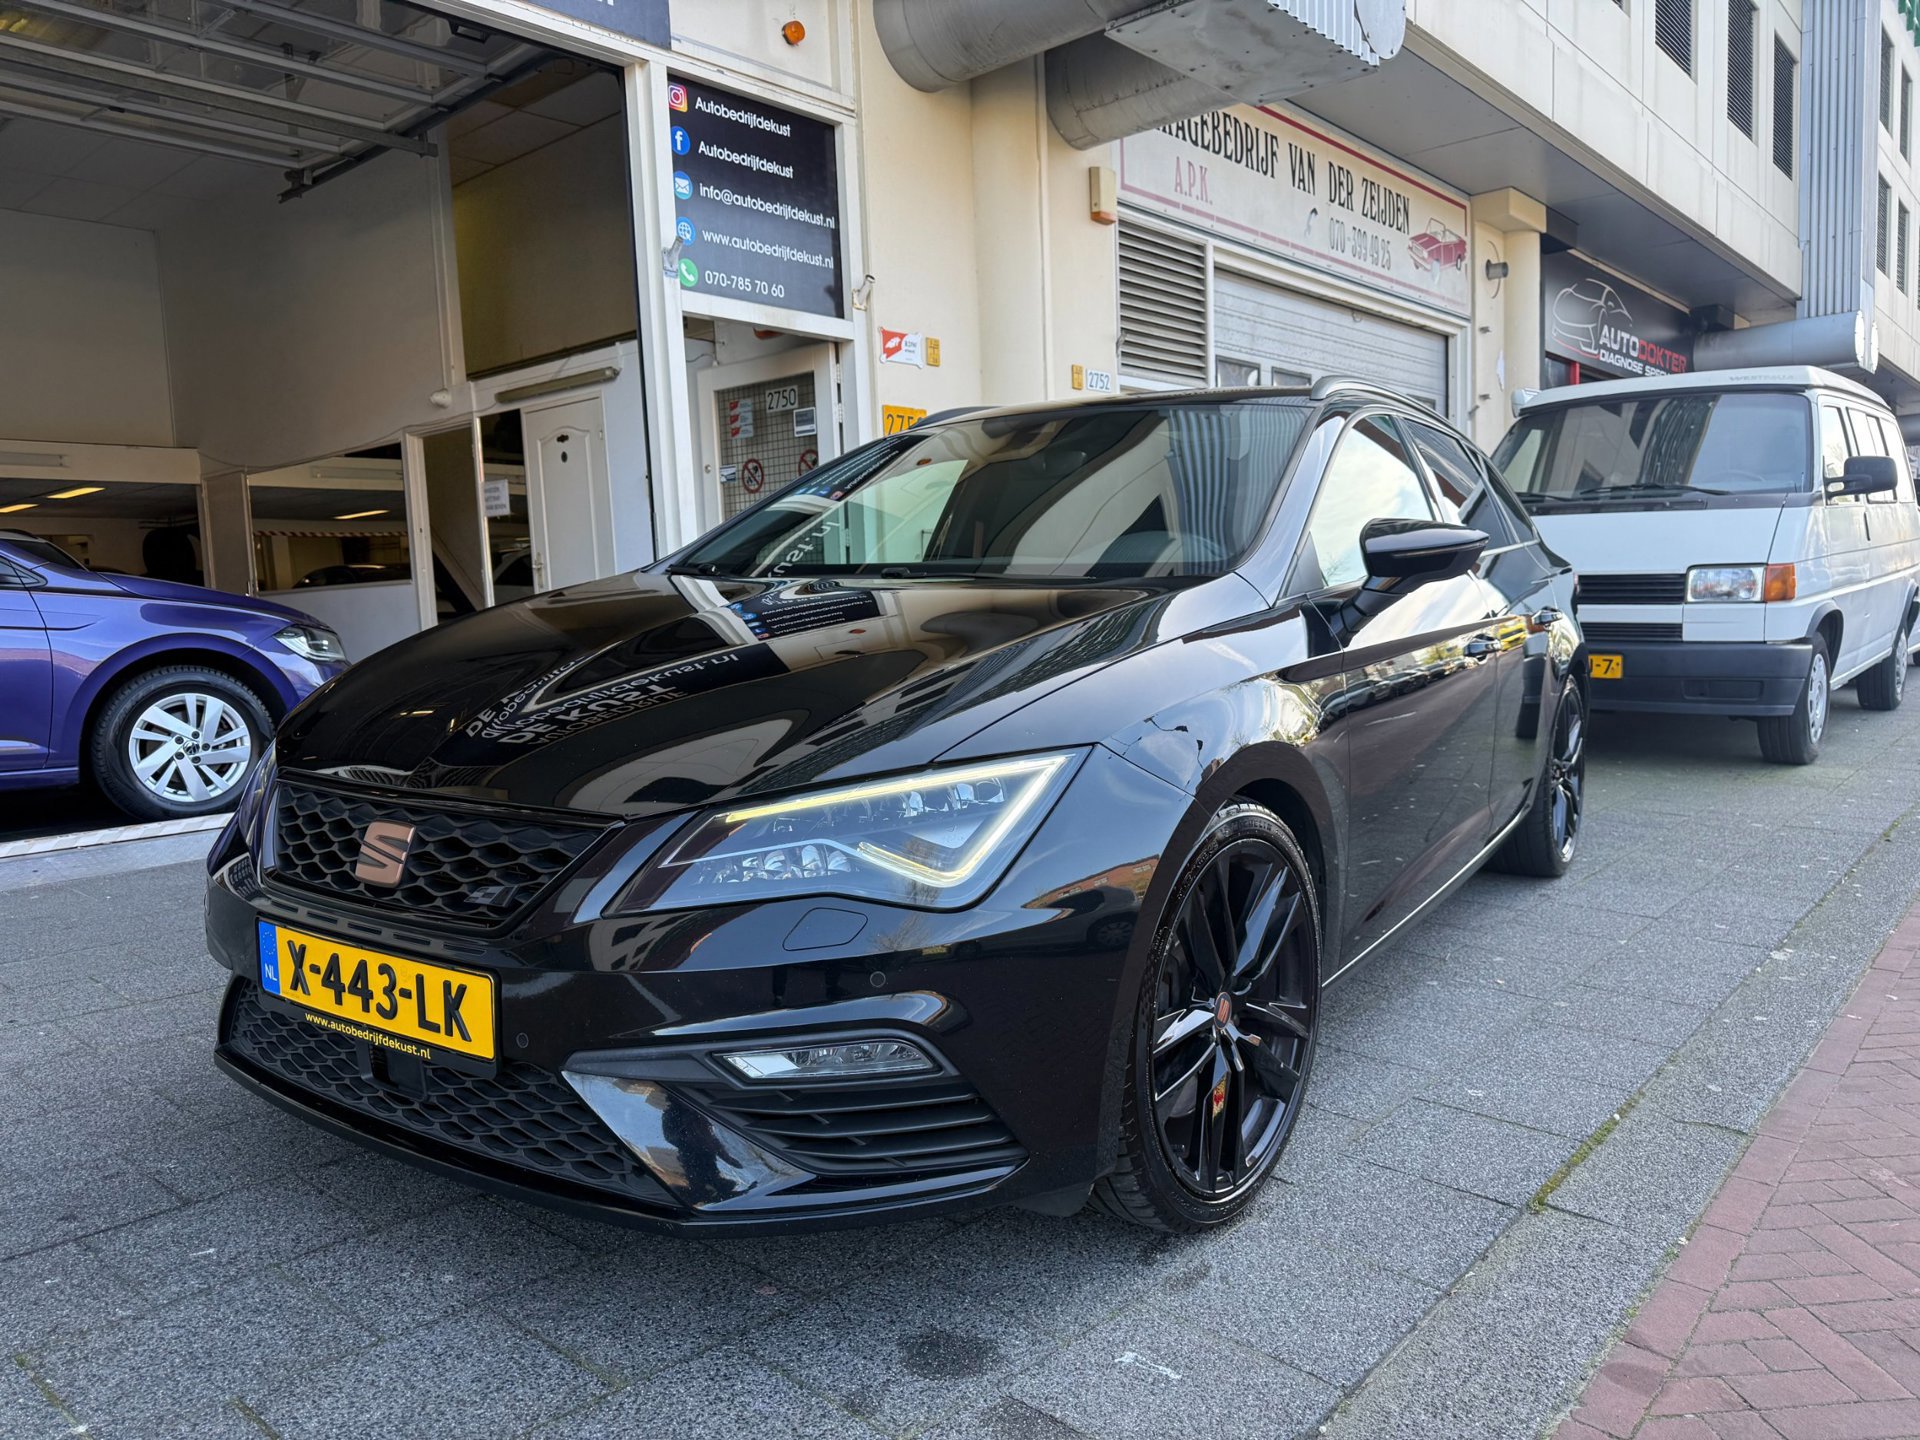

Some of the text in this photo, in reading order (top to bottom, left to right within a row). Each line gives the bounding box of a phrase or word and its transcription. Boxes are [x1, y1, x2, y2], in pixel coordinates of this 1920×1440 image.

[695, 97, 791, 137] Autobedrijfdekust
[698, 140, 793, 179] Autobedrijfdekust
[699, 182, 836, 230] info@autobedrijfdekust.nl
[1288, 142, 1316, 196] VAN
[1328, 161, 1354, 212] DER
[1361, 177, 1410, 235] ZEIJDEN
[702, 229, 835, 270] www.autobedrijfdekust.nl
[705, 269, 786, 299] 070-785 70 60
[1599, 324, 1687, 374] AUTODOKTER
[1600, 349, 1644, 375] DIAGNOSE
[767, 388, 797, 411] 2750
[1088, 371, 1111, 391] 2752
[264, 962, 278, 982] NL
[286, 939, 473, 1043] X-443-LK
[304, 1011, 432, 1060] www.autobedrijfdekust.nl
